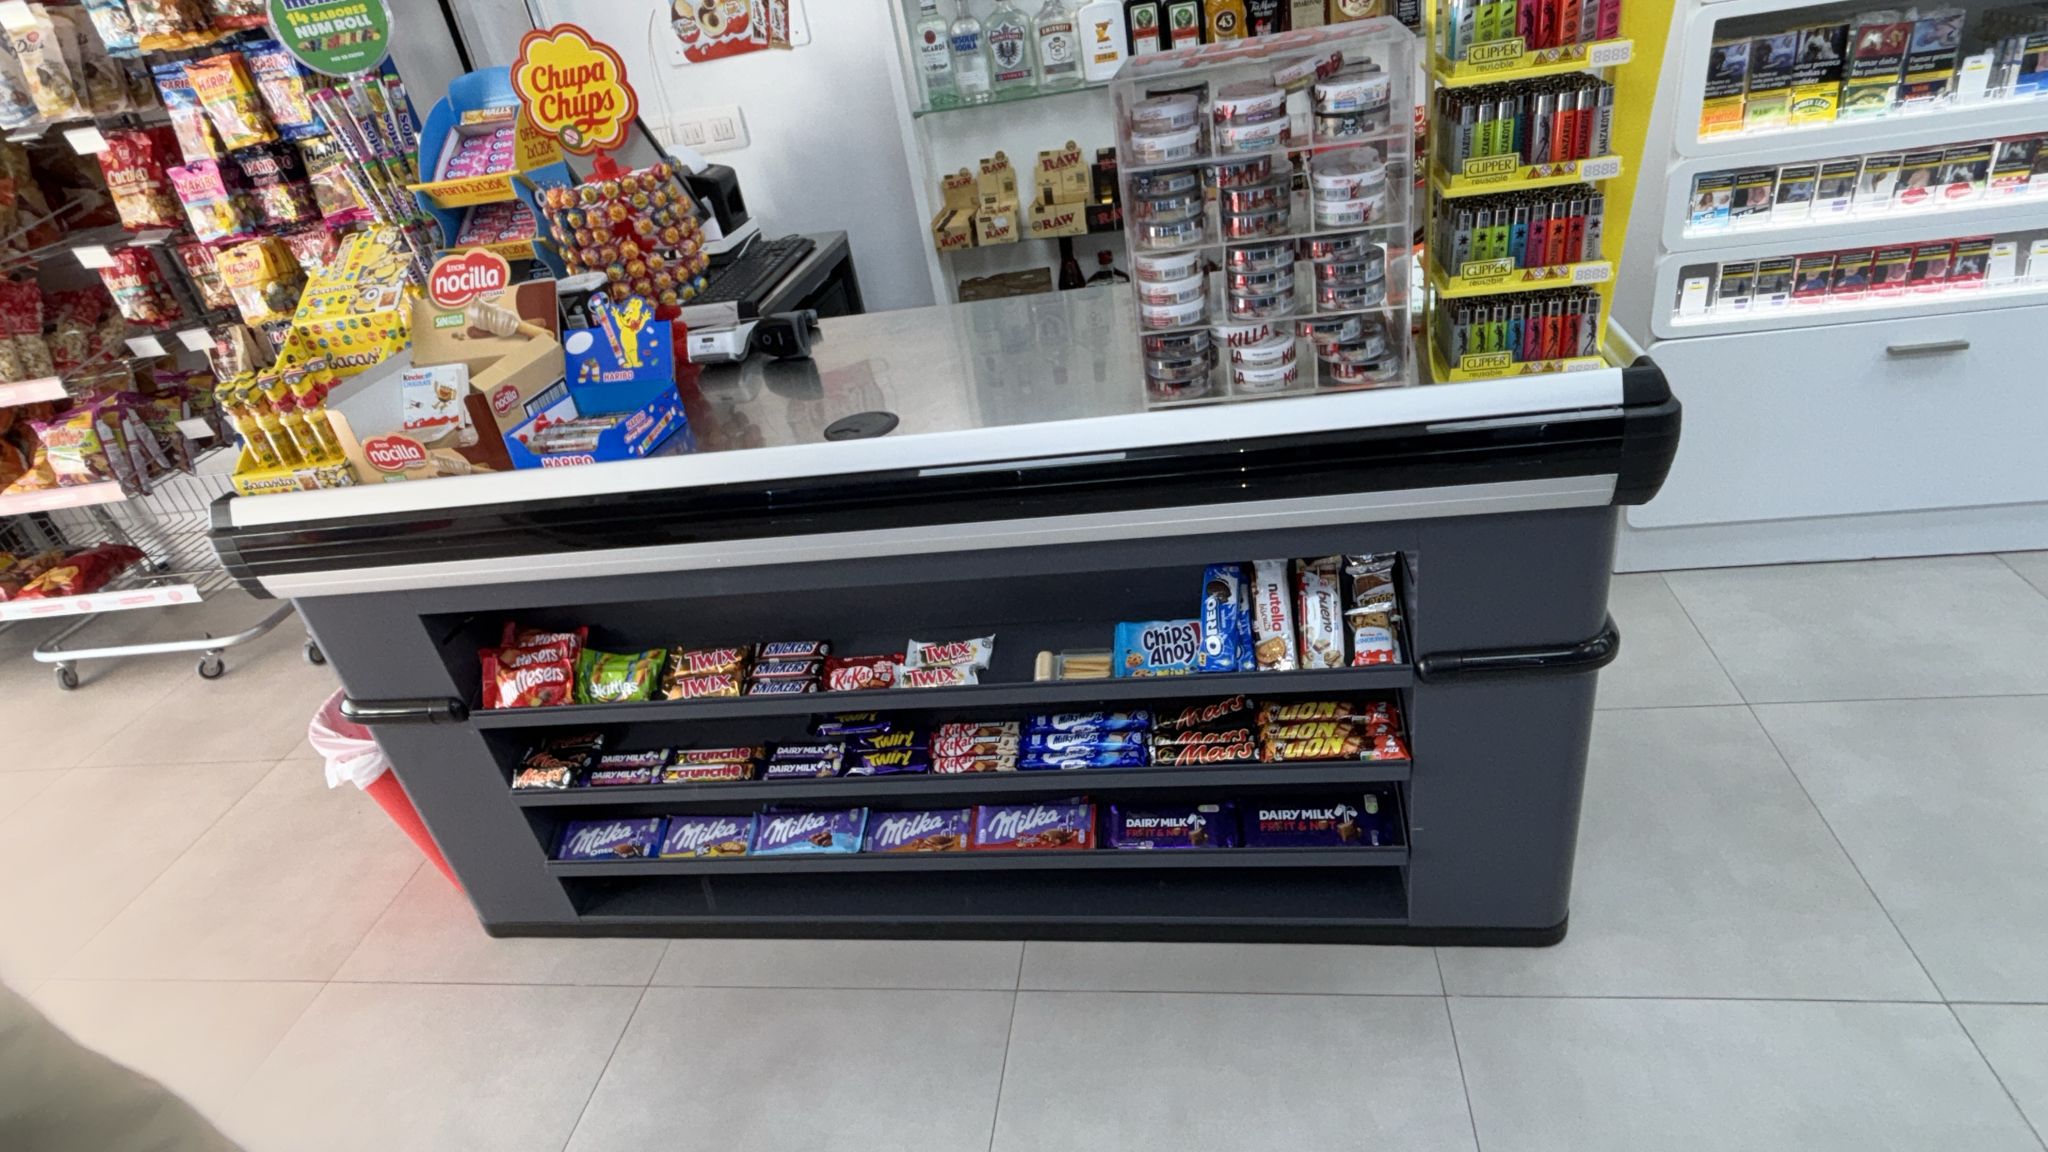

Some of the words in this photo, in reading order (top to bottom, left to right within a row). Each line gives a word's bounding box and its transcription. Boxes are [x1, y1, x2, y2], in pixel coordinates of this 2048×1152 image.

[287, 11, 309, 26] 14
[311, 4, 368, 21] SABORES
[1216, 14, 1234, 28] 43
[294, 20, 334, 39] NUM
[334, 14, 373, 31] ROLL
[1472, 43, 1520, 61] CLIPPER
[1475, 60, 1515, 73] reusable
[160, 77, 191, 90] HARIB
[531, 61, 606, 94] Chupa
[539, 88, 615, 128] Chups
[520, 127, 537, 142] OFE
[1599, 109, 1611, 156] LANZAROTE
[981, 161, 1008, 175] RAW
[1042, 152, 1081, 172] RAW
[1469, 159, 1513, 175] CLIPPER
[179, 174, 219, 194] HARIBO
[1471, 174, 1508, 186] reusable
[432, 182, 468, 197] OFERTA
[1042, 213, 1075, 230] RAW
[940, 232, 967, 248] RAW
[985, 226, 1010, 240] RAW
[225, 257, 260, 274] HARIBO
[1466, 261, 1508, 277] CLIPPER
[435, 265, 500, 295] nocilla
[1227, 324, 1269, 348] KILLA
[1467, 355, 1507, 369] CLIPPER
[603, 371, 633, 383] HARIBO
[1469, 369, 1503, 378] reusable
[494, 389, 519, 410] nocilla
[369, 446, 420, 463] nocilla
[542, 455, 595, 469] HARIBO
[1268, 583, 1284, 632] nutella
[1317, 590, 1333, 633] bueno
[1258, 603, 1271, 632] biscuits
[1206, 598, 1222, 655] OREO
[1143, 626, 1192, 651] Chips
[766, 642, 816, 655] SNICKERS
[756, 661, 807, 675] SNICKERS
[834, 667, 871, 690] KitKat
[590, 680, 639, 698] Skittles
[751, 681, 804, 694] SNICKERS
[1175, 694, 1246, 730] Mars
[1279, 702, 1337, 722] LION
[942, 722, 978, 738] KitKat
[1175, 729, 1249, 745] Mars
[1279, 723, 1335, 739] LION
[936, 736, 975, 756] KitKat
[1284, 737, 1346, 759] LION
[1386, 736, 1396, 747] 2
[601, 755, 625, 763] DAIRY
[626, 753, 646, 763] MILK
[776, 747, 802, 755] DAIRY
[803, 746, 825, 754] MILK
[1175, 741, 1255, 767] Mars
[677, 766, 742, 778] crunchie
[768, 765, 794, 773] DAIRY
[795, 764, 817, 773] MILK
[938, 755, 976, 774] KitKat
[592, 771, 616, 779] DAIRY
[617, 769, 638, 779] MILK
[988, 805, 1061, 839] Milka
[1126, 818, 1160, 828] DAIRY
[1161, 817, 1188, 828] MILK
[1259, 809, 1300, 820] DAIRY
[1301, 809, 1335, 820] MILK
[672, 818, 738, 853] Milka
[764, 813, 827, 844] Milka
[875, 811, 945, 846] Milka
[568, 822, 634, 856] Milka
